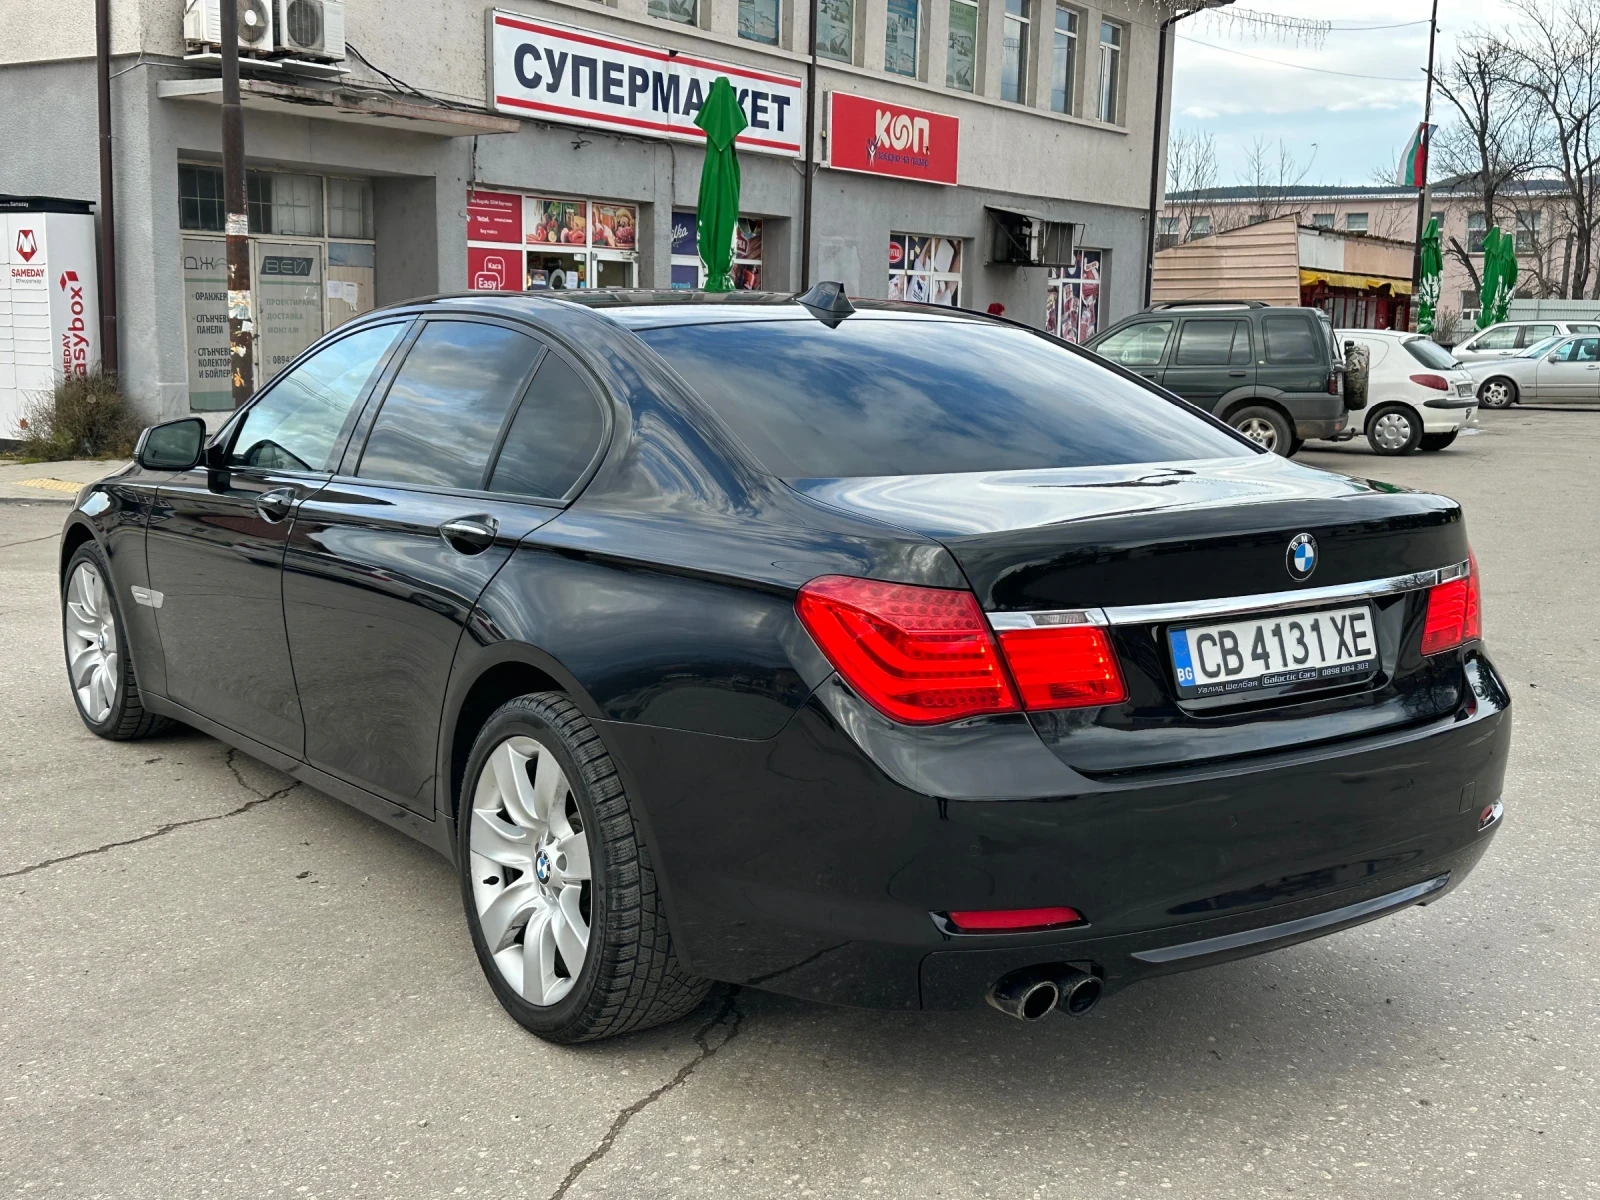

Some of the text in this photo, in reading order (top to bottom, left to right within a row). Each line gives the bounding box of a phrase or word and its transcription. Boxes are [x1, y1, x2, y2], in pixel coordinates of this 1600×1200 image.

[513, 42, 791, 132] СУПЕРМАКЕТ
[876, 109, 930, 154] КОП
[11, 268, 45, 278] SAMEDAY
[265, 259, 308, 275] ВЕЙ
[478, 277, 497, 290] Easy
[195, 292, 228, 301] ОРАНЖЕР
[266, 312, 304, 321] ДОСТАВКА
[67, 286, 90, 377] asybox
[197, 325, 224, 334] ПАНЕЛИ
[267, 326, 299, 334] МОНТАЖ
[62, 333, 73, 383] AMEDAY
[198, 358, 232, 368] КОЛЕКТОР
[198, 368, 231, 379] И БОЙЛЕР
[1251, 618, 1326, 671] 4131
[1177, 667, 1193, 682] BG
[1264, 672, 1297, 684] Galactic
[1298, 669, 1316, 680] Cars
[1321, 666, 1340, 676] 0898
